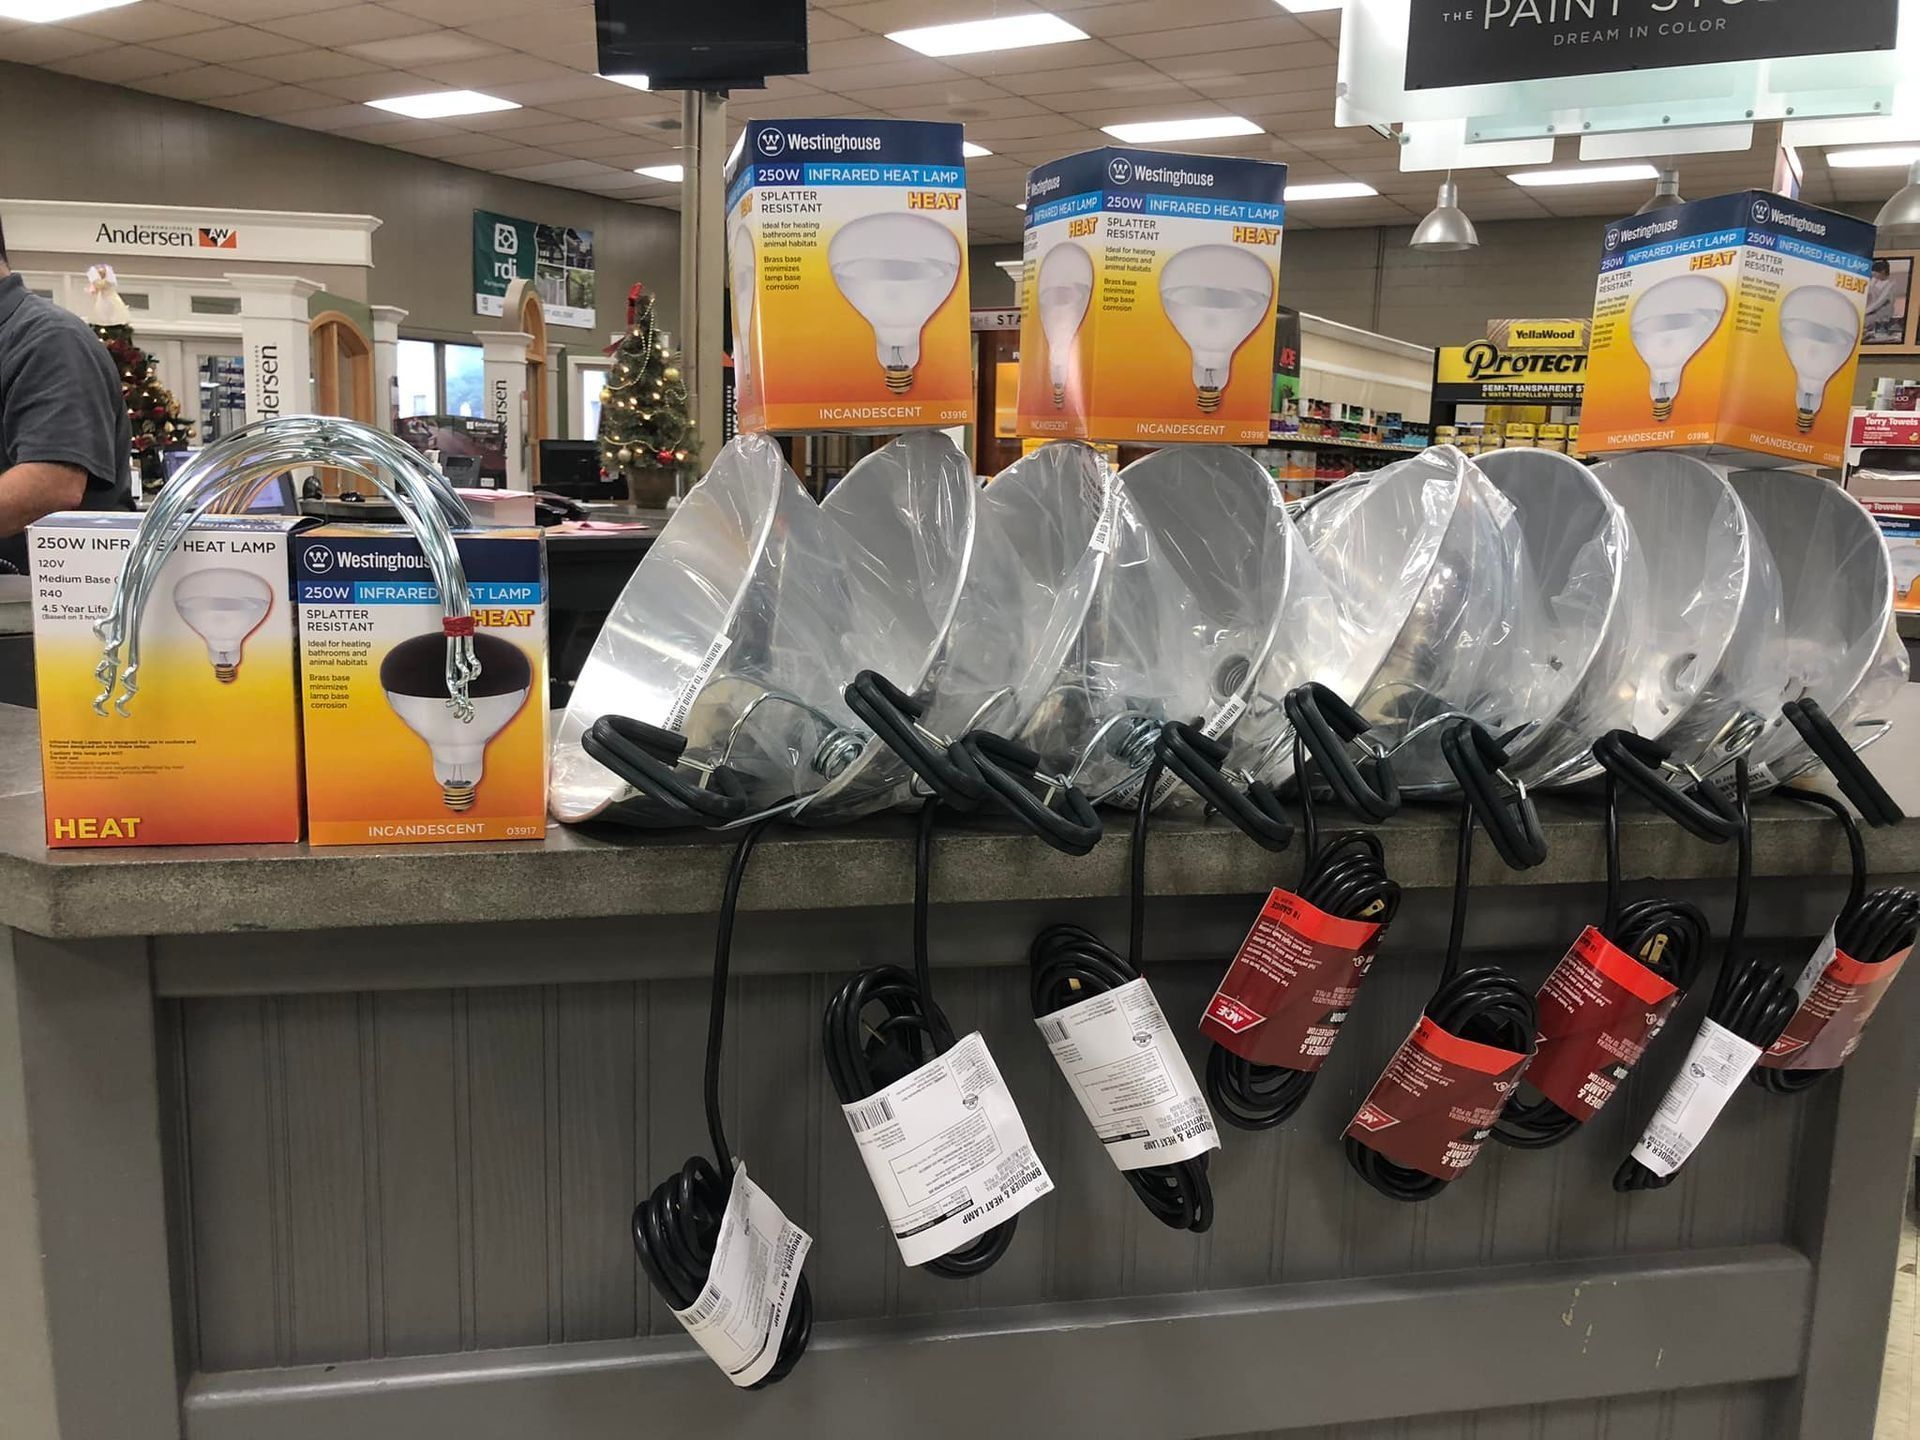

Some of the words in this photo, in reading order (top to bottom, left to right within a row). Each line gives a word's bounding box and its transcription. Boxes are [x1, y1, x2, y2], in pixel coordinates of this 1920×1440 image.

[1443, 11, 1473, 22] THE
[1554, 29, 1620, 46] DREAM
[1629, 26, 1648, 39] IN
[1658, 18, 1727, 36] COLOR
[788, 134, 881, 153] Westinghouse
[759, 169, 800, 182] 250W
[808, 169, 879, 182] INFRARED
[884, 170, 918, 182] HEAT
[923, 170, 958, 183] LAMP
[1134, 165, 1214, 187] Westinghouse
[761, 191, 817, 201] SPLATTER
[908, 191, 961, 210] HEAT
[761, 203, 823, 213] RESISTANT
[1059, 200, 1075, 216] HEAT
[1077, 197, 1098, 211] LAMP
[1107, 197, 1143, 210] 250W
[1150, 200, 1211, 215] INFRARED
[1214, 205, 1245, 219] HEAT
[1248, 207, 1279, 220] LAMP
[781, 221, 791, 229] for
[793, 221, 820, 230] heating
[1068, 217, 1098, 238] HEAT
[1107, 217, 1156, 229] SPLATTER
[1771, 207, 1827, 237] Westinghouse
[96, 223, 194, 247] Andersen
[762, 231, 801, 239] bathrooms
[1106, 229, 1160, 240] RESISTANT
[1232, 226, 1279, 245] HEAT
[1620, 218, 1678, 243] Westinghouse
[763, 240, 787, 248] animal
[1132, 248, 1155, 256] heating
[1601, 256, 1625, 270] 250W
[1628, 245, 1673, 262] INFRARED
[1675, 239, 1702, 253] HEAT
[1705, 233, 1737, 248] LAMP
[1745, 250, 1783, 266] SPLATTER
[1747, 232, 1776, 246] 250W
[1780, 240, 1822, 258] INFRARED
[1824, 250, 1846, 265] HEAT
[1847, 258, 1870, 271] LAMP
[1105, 255, 1139, 263] bathrooms
[1689, 251, 1736, 271] HEAT
[494, 258, 517, 279] rdi
[1744, 260, 1784, 276] RESISTANT
[1104, 278, 1121, 286] Brass
[1600, 271, 1632, 284] SPLATTER
[1836, 273, 1868, 294] HEAT
[1103, 287, 1135, 295] minimizes
[1599, 279, 1633, 292] RESISTANT
[1102, 304, 1132, 312] corrosion
[1516, 330, 1575, 339] YellaWood
[1464, 339, 1588, 379] PROTECT
[257, 345, 279, 432] dersen
[1482, 384, 1573, 392] SEMI-TRANSPARENT
[496, 380, 508, 425] ersen
[819, 407, 922, 420] INCANDESCENT
[940, 410, 968, 420] 03916
[1865, 418, 1886, 426] Terry
[1889, 418, 1918, 426] Towels
[1136, 423, 1226, 436] INCANDESCENT
[1240, 431, 1265, 440] 03916
[1607, 430, 1675, 444] INCANDESCENT
[1749, 434, 1815, 455] INCANDESCENT
[1874, 503, 1903, 511] Towels
[37, 537, 85, 550] 250W
[184, 541, 226, 552] HEAT
[231, 542, 276, 553] LAMP
[38, 560, 65, 568] 120V
[337, 551, 431, 571] Westinghous
[39, 575, 82, 583] Medium
[85, 575, 111, 584] Base
[40, 590, 63, 598] R40
[305, 587, 349, 599] 250W
[360, 588, 439, 599] INFRARED
[467, 588, 485, 599] AT
[489, 588, 531, 599] LAMP
[41, 604, 58, 612] 4.5
[88, 605, 108, 613] Life
[306, 610, 369, 619] SPLATTER
[470, 609, 535, 627] HEAT
[307, 622, 374, 631] RESISTANT
[341, 640, 371, 648] heating
[308, 649, 350, 657] bathrooms
[352, 649, 367, 657] and
[700, 641, 724, 674] WARNING:
[309, 658, 334, 666] animal
[693, 674, 703, 685] TO
[310, 692, 329, 700] lamp
[331, 692, 349, 700] base
[683, 684, 698, 706] AVOID
[671, 704, 687, 732] DANGER
[54, 817, 143, 840] HEAT
[368, 823, 485, 838] INCANDESCENT
[506, 826, 538, 836] 03917
[1216, 1004, 1245, 1024] ACE
[1304, 1035, 1327, 1046] LAMP
[1299, 1044, 1307, 1054] &
[1577, 1088, 1586, 1099] &
[1584, 1082, 1607, 1099] LAMP
[1359, 1111, 1377, 1124] AC
[1172, 1115, 1204, 1134] REFLECTOR
[1161, 1136, 1177, 1148] HEAT
[1177, 1133, 1185, 1142] &
[1143, 1139, 1160, 1151] LAMP
[1646, 1141, 1653, 1150] &
[1441, 1155, 1449, 1165] &
[1445, 1149, 1471, 1159] LAMP
[999, 1168, 1025, 1192] REFLECTOR
[1010, 1166, 1042, 1195] BROODER
[1003, 1189, 1010, 1199] &
[985, 1194, 1005, 1212] HEAT
[962, 1206, 985, 1225] LAMP
[786, 1233, 803, 1271] BROODER
[779, 1280, 788, 1301] HEAT
[774, 1302, 783, 1328] LAMP
